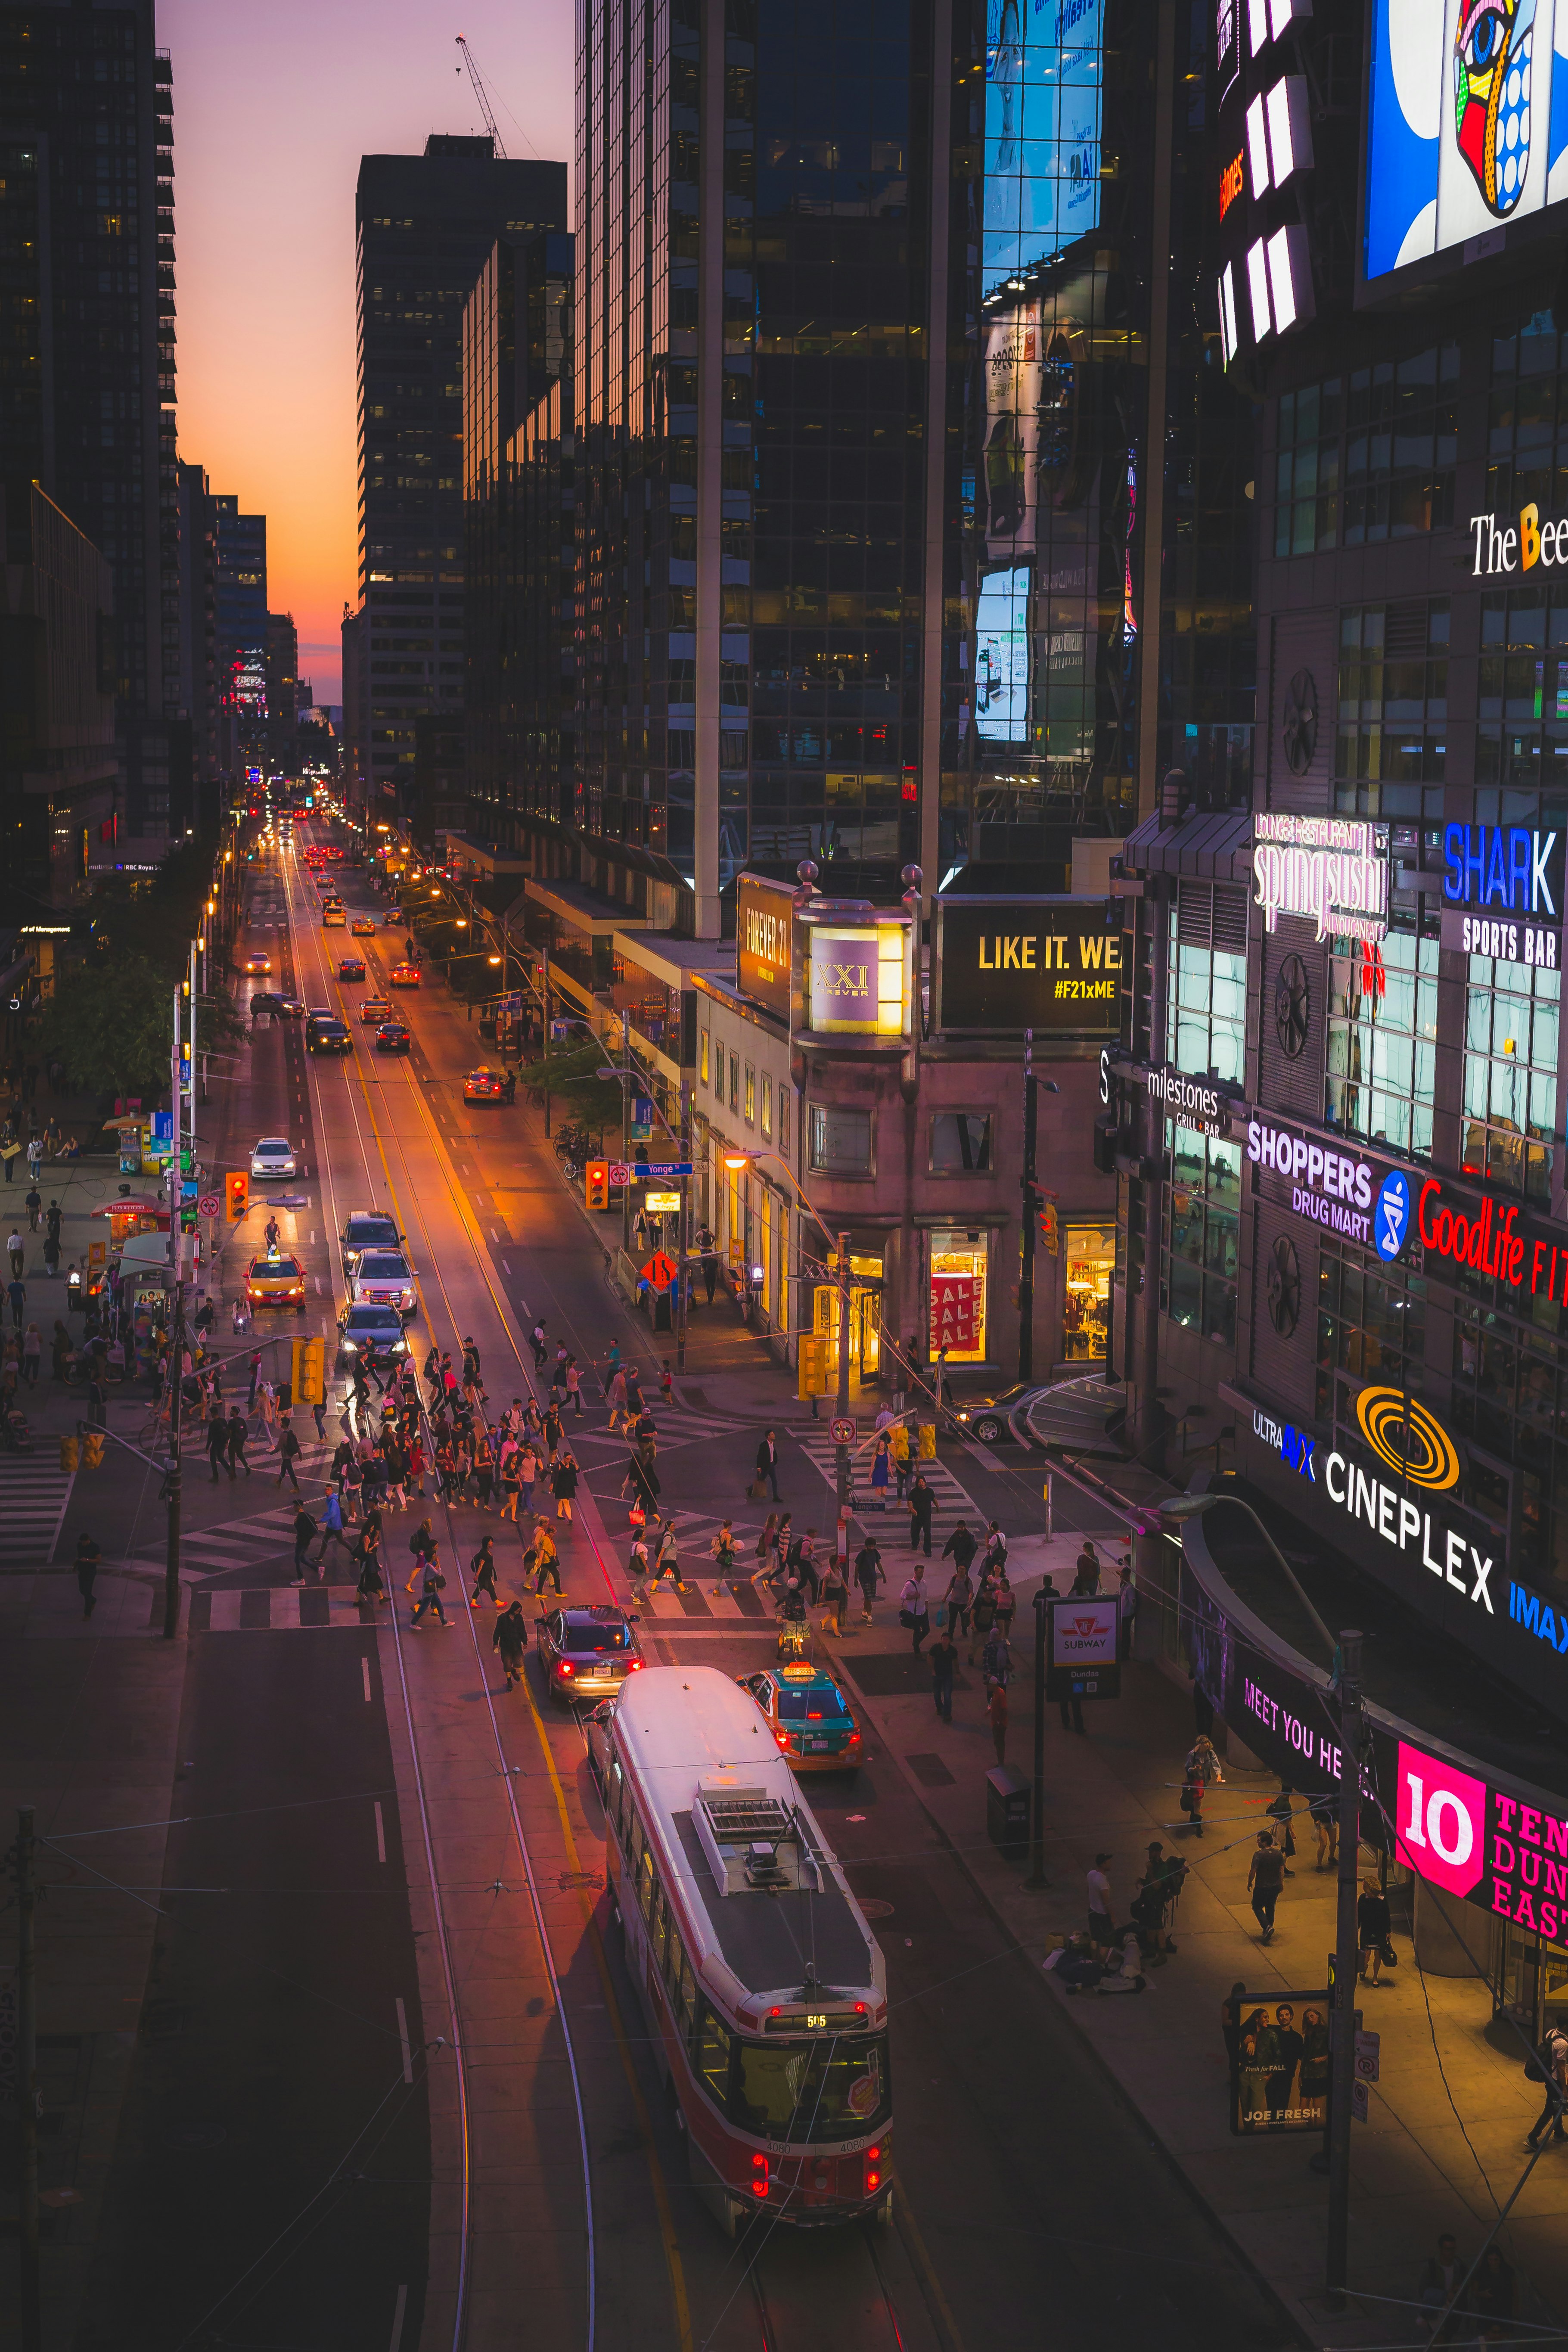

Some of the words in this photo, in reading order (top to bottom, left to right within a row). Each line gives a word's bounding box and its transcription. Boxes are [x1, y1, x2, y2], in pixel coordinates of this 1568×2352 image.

[1470, 513, 1517, 575] The
[1520, 503, 1568, 572] Bee
[1444, 823, 1556, 915] SHARK
[746, 907, 776, 963] FOREVER
[779, 919, 787, 968] 21
[979, 936, 1036, 969] LIKE
[1045, 936, 1070, 969] IT.
[1079, 936, 1122, 969] WE
[1463, 917, 1517, 961] SPORTS
[1525, 929, 1556, 968] BAR
[816, 963, 869, 989] XXI
[1054, 980, 1115, 998] #F21xME
[1148, 1066, 1218, 1116] milestones
[1177, 1112, 1197, 1132] GRILL
[1205, 1121, 1220, 1139] BAR
[649, 1165, 674, 1175] Yonge
[1247, 1121, 1372, 1209] SHOPPERS
[1293, 1187, 1329, 1225] DRUG
[1331, 1204, 1370, 1243] MART
[1419, 1179, 1524, 1286] GoodLife
[930, 1279, 982, 1306] SALE
[930, 1299, 981, 1327] SALE
[930, 1320, 980, 1348] SALE
[1326, 1451, 1494, 1615] CINEPLEX
[1509, 1581, 1568, 1654] IMAX
[1064, 1639, 1106, 1649] SUBWAY
[1245, 1678, 1279, 1731] MEET
[1283, 1710, 1313, 1759] YOU
[1406, 1772, 1473, 1866] 10
[1495, 1793, 1568, 1858] TEN
[1356, 2038, 1379, 2049] STANDING
[1244, 2110, 1271, 2122] JOE
[1276, 2107, 1321, 2119] FRESH
[767, 2143, 791, 2154] 4080
[840, 2139, 865, 2153] 4080
